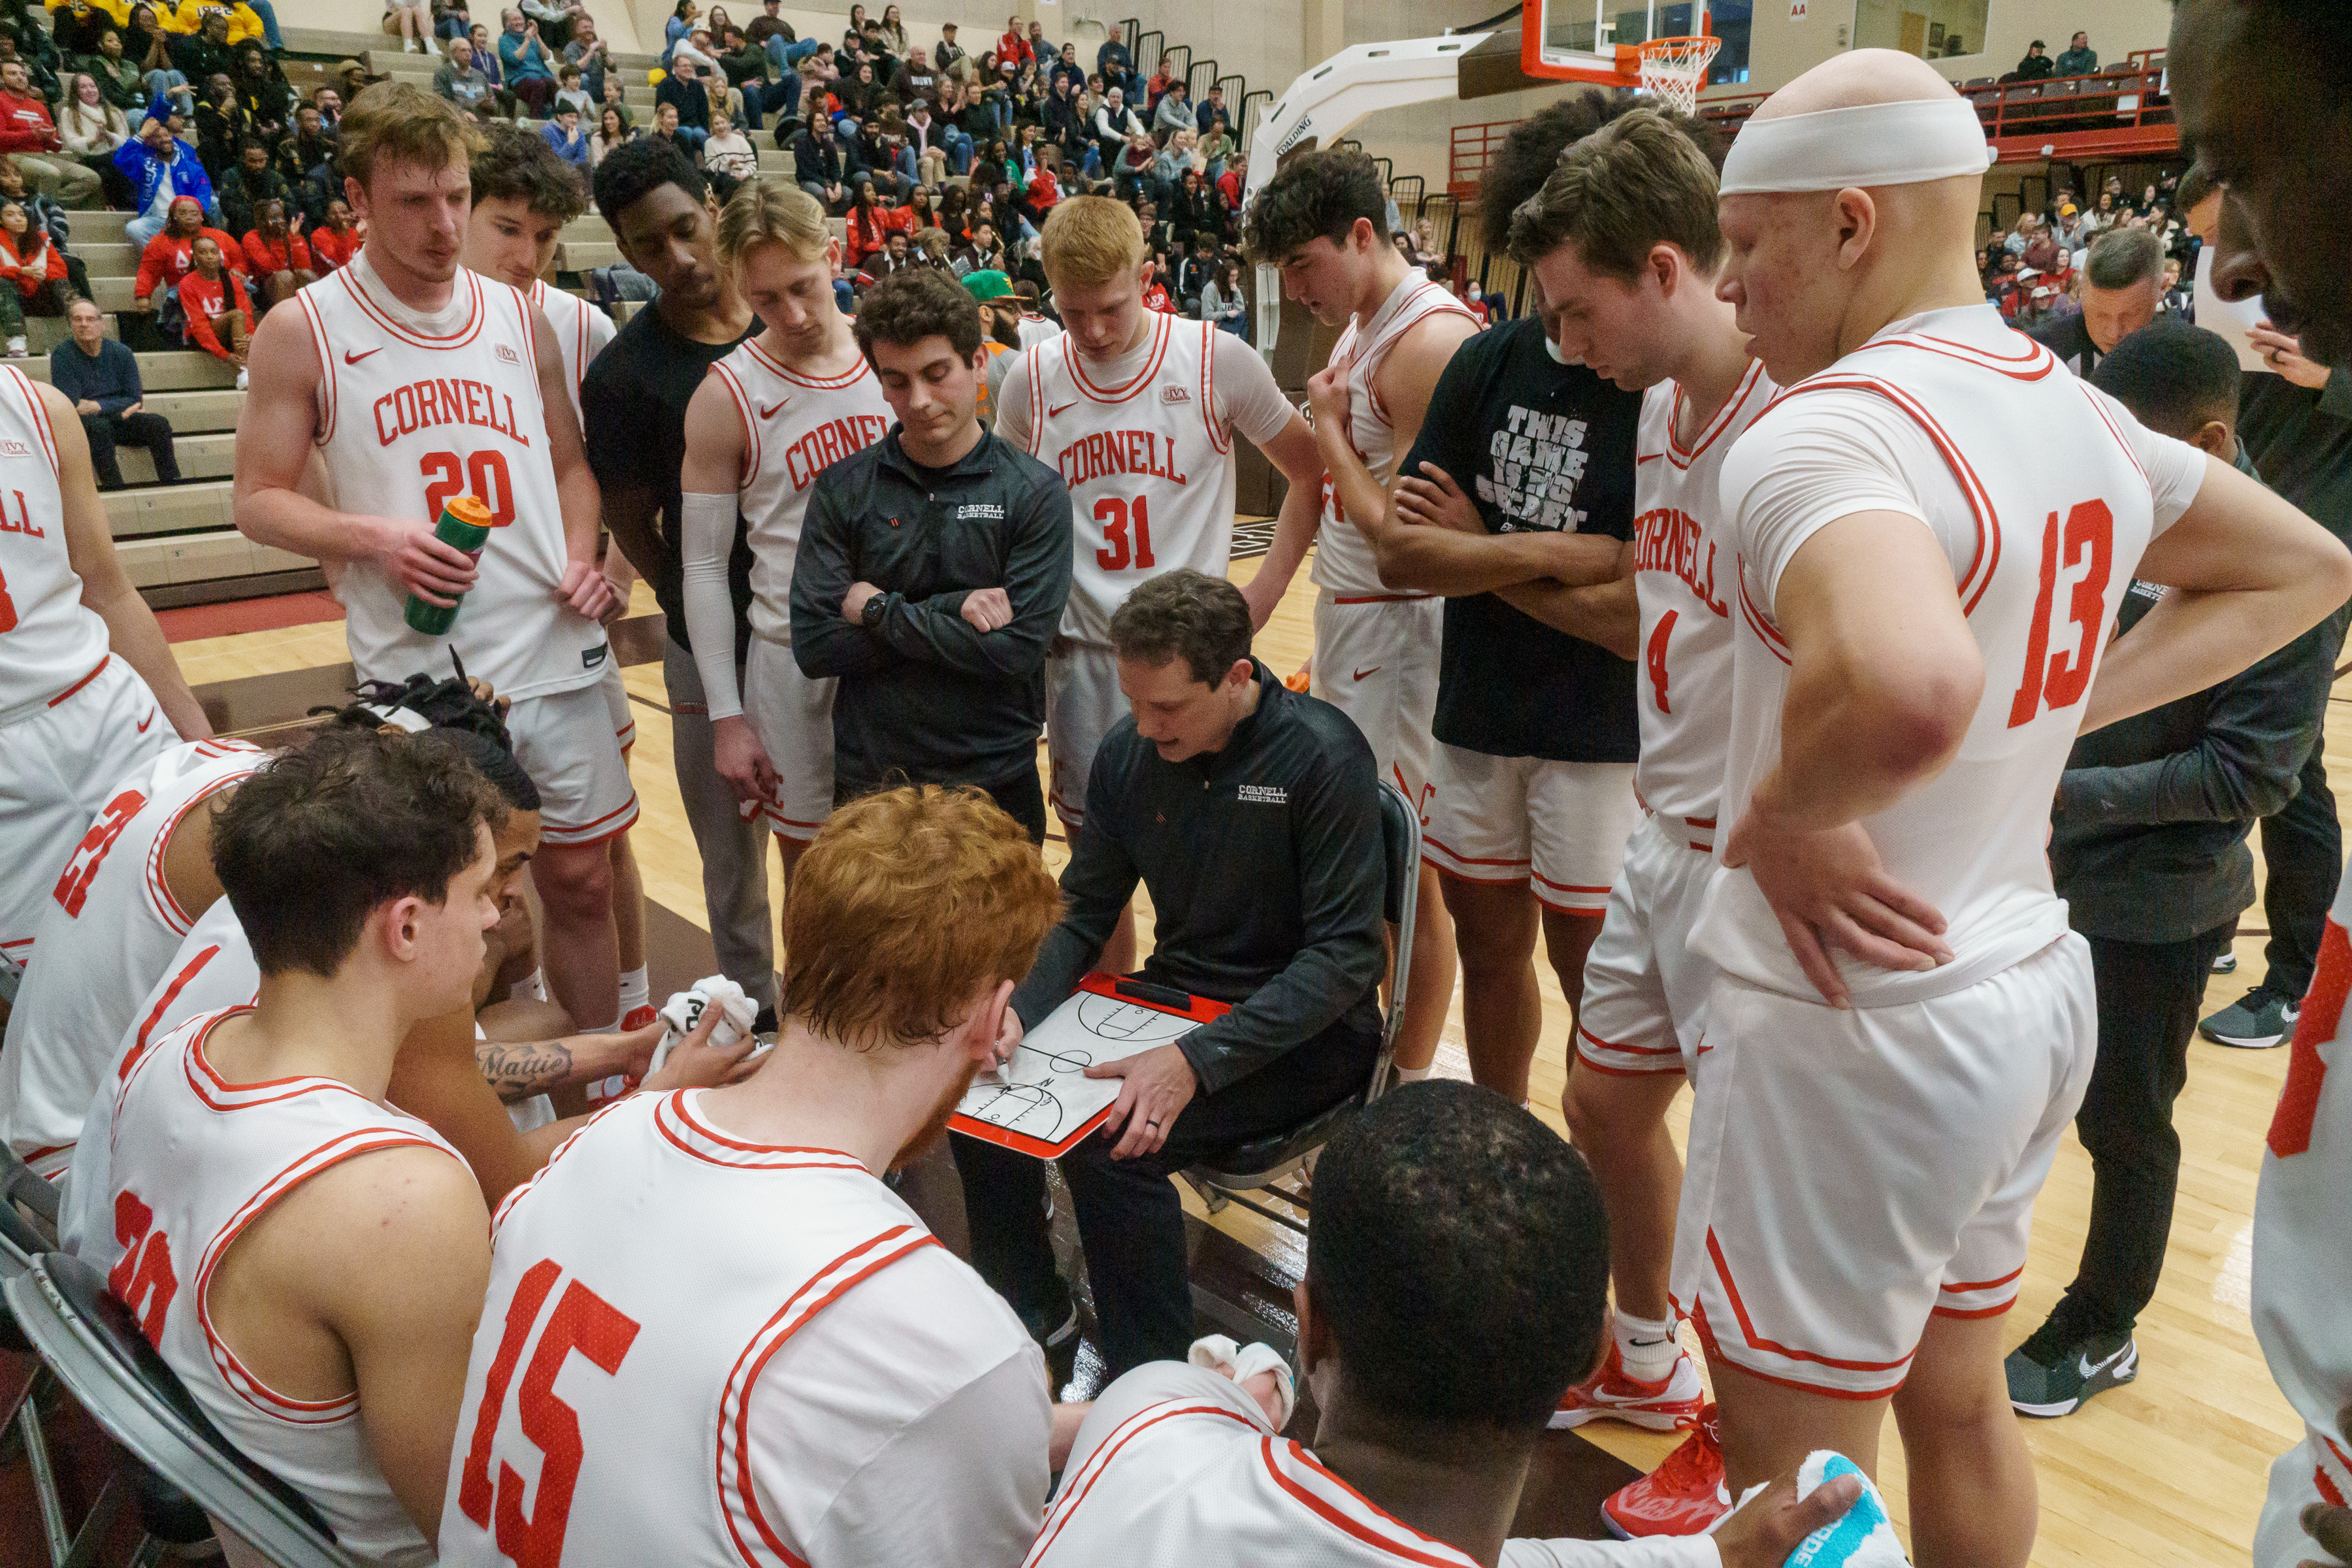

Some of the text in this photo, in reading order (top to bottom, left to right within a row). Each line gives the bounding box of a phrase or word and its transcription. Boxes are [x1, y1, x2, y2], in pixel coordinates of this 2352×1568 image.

[1791, 3, 1806, 16] AA
[373, 378, 530, 448] CORNELL
[419, 449, 516, 529] 20
[1058, 430, 1186, 491] CORNELL
[958, 504, 1005, 514] CORNELL
[1094, 495, 1155, 571] 31
[2007, 498, 2114, 729] 13
[1647, 609, 1679, 715] 4
[1237, 793, 1286, 804] BASKETBALL
[1239, 785, 1288, 796] CORNELL
[459, 1258, 642, 1568] 15
